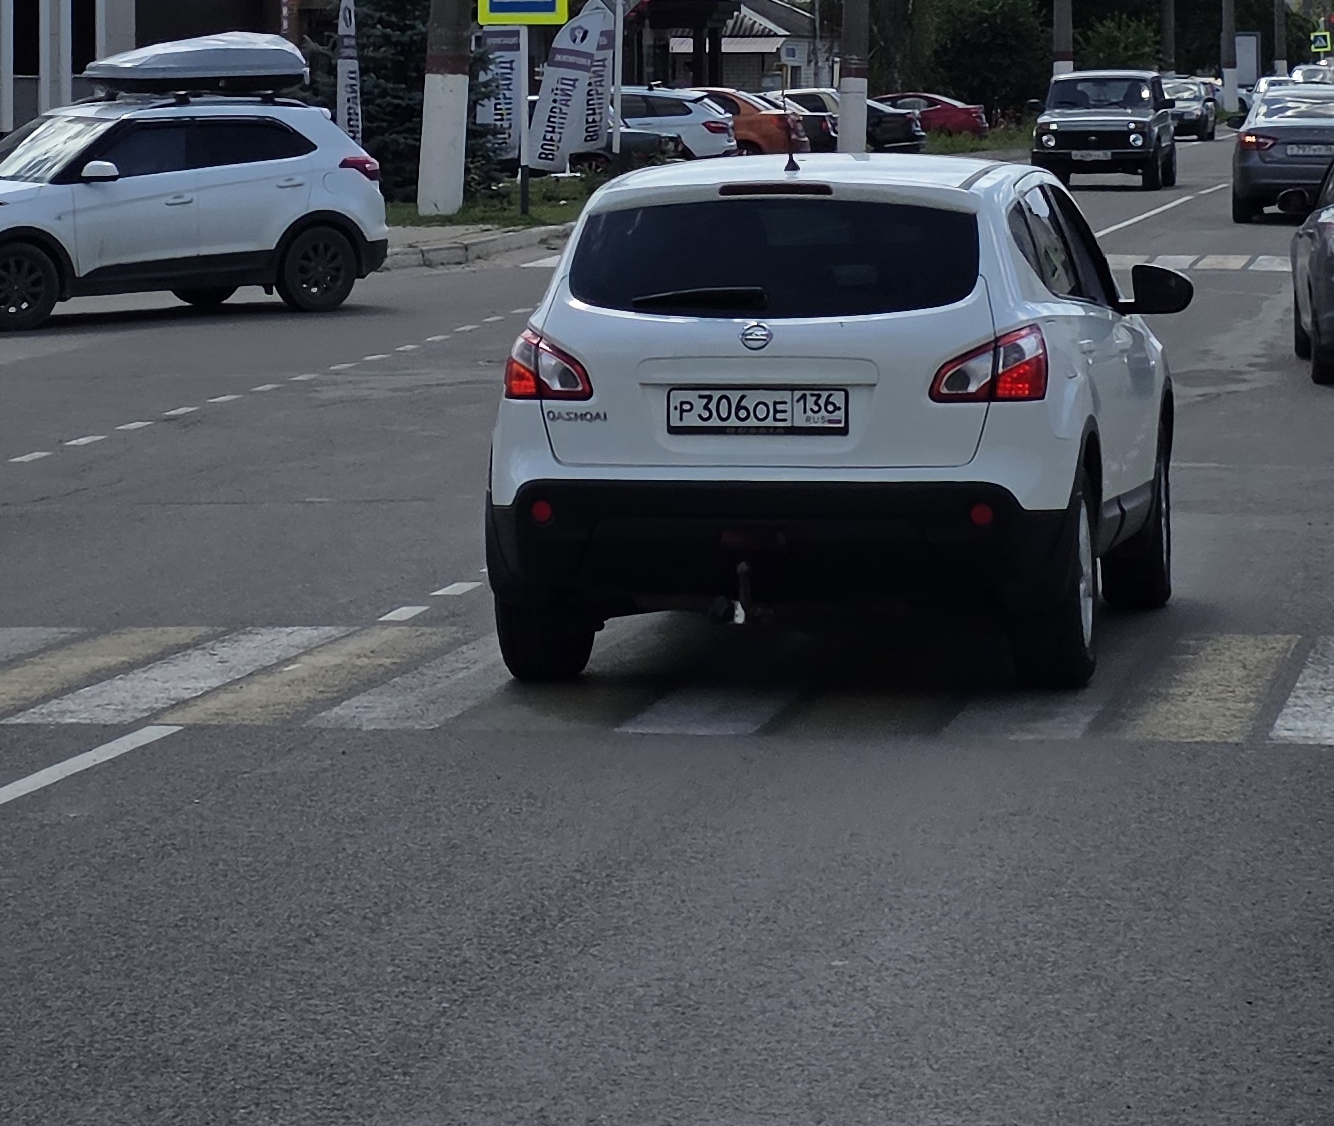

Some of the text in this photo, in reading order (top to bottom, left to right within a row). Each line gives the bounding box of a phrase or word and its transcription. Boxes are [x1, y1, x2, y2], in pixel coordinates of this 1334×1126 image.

[538, 76, 580, 162] ВОЕНПРАЙД
[547, 410, 608, 423] QASHQAI
[679, 393, 838, 422] Р306ОЕ 136
[805, 416, 827, 424] RUS
